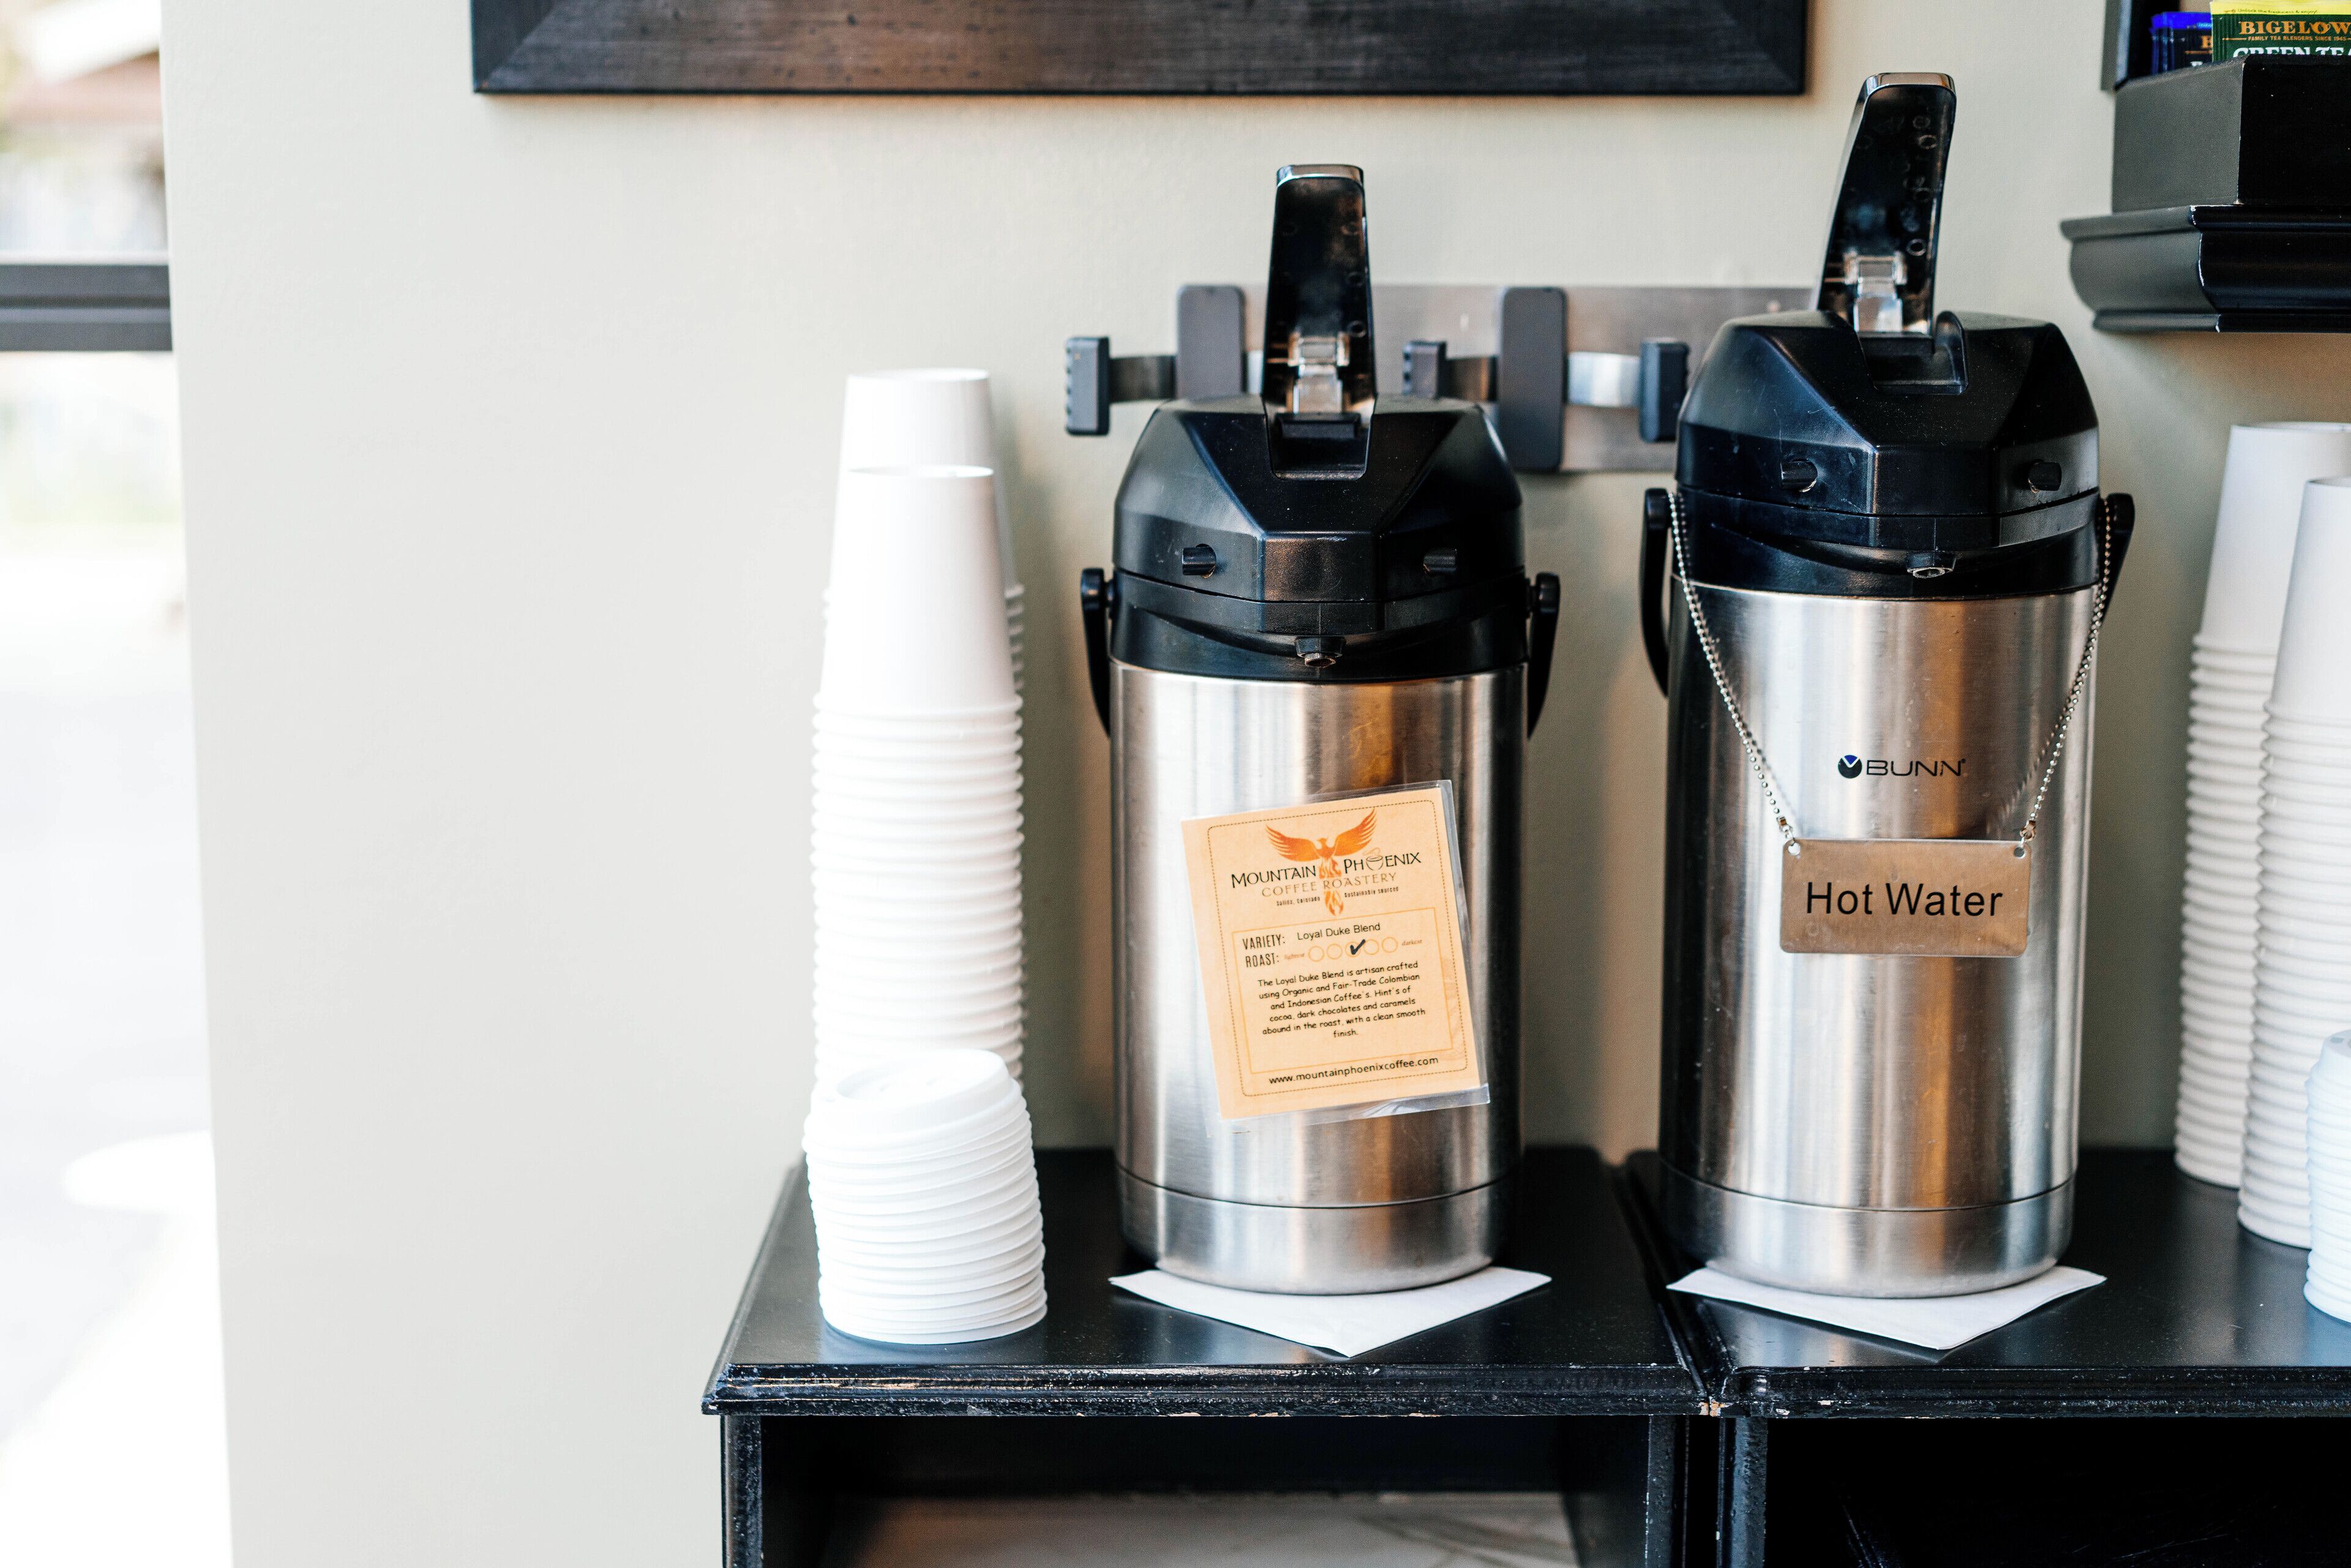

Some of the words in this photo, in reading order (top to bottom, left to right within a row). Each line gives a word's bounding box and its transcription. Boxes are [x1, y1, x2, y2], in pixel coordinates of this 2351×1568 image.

[2238, 21, 2351, 35] BIGELOW
[1231, 865, 1317, 888] MOUNTAIN
[1262, 881, 1318, 898] COFFEE
[1323, 872, 1397, 889] ROASTERY
[1806, 882, 1873, 915] Hot
[1886, 883, 2003, 917] Water
[1243, 934, 1286, 950] VARIETY:
[1297, 929, 1322, 941] Loyal
[1325, 927, 1351, 937] Duke
[1353, 923, 1381, 934] Blend
[1245, 953, 1280, 968] ROAST:
[1258, 979, 1273, 988] The
[1275, 976, 1297, 986] Loyal
[1299, 973, 1319, 983] Duke
[1322, 970, 1344, 980] Blend
[1355, 966, 1384, 975] artisan
[1387, 961, 1418, 972] crafted
[1282, 986, 1313, 997] Organic
[1333, 978, 1376, 990] Fair-Trade
[1379, 973, 1420, 984] Colombian
[1270, 1002, 1285, 1010] and
[1288, 997, 1332, 1008] Indonesian
[1374, 987, 1400, 997] Hint's
[1402, 985, 1411, 994] of
[1270, 1013, 1295, 1022] cocoa,
[1297, 1010, 1316, 1019] dark
[1318, 1005, 1361, 1016] chocolates
[1380, 997, 1416, 1008] caramels
[1262, 1026, 1291, 1035] abound
[1303, 1021, 1317, 1029] the
[1319, 1019, 1344, 1028] roast,
[1346, 1016, 1364, 1025] with
[1373, 1012, 1394, 1021] clean
[1396, 1008, 1426, 1019] smooth
[1333, 1029, 1359, 1039] finish.
[1268, 1057, 1439, 1084] www.mountainphoenixcoffee.com
